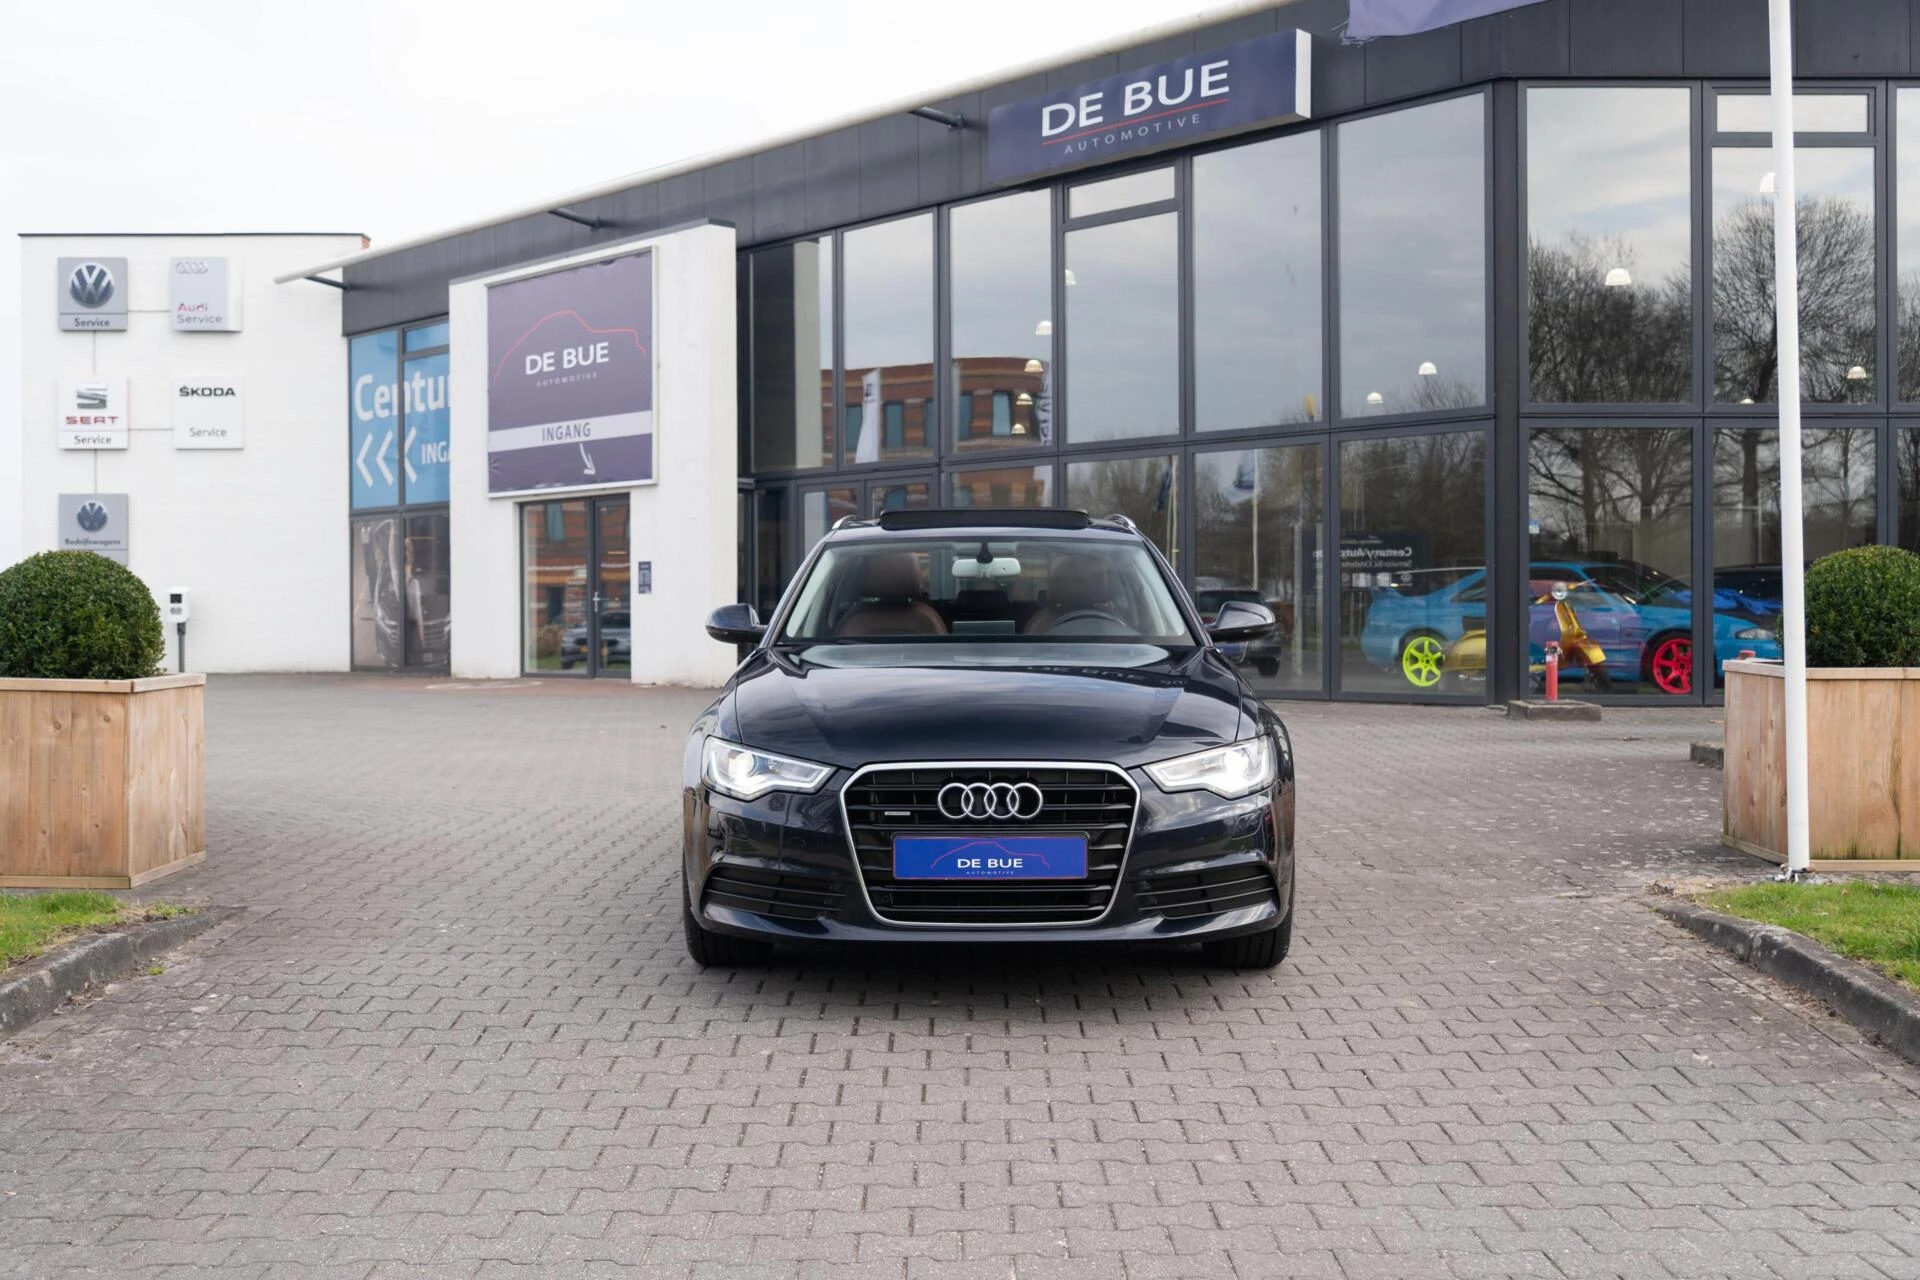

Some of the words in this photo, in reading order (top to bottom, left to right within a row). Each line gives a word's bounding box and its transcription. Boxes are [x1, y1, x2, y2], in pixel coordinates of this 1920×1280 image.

[1041, 91, 1104, 137] DE
[1123, 59, 1230, 117] BUE
[1063, 113, 1201, 155] AUTOMOTIVE
[177, 303, 209, 313] Audi
[74, 317, 111, 328] Service
[177, 314, 223, 324] Service
[525, 351, 556, 375] DE
[562, 341, 610, 369] BUE
[536, 371, 598, 387] AUTOMOTIVE
[355, 370, 450, 421] Centu
[65, 416, 119, 425] SEAT
[189, 427, 228, 438] Service
[541, 422, 592, 442] INGANG
[74, 435, 112, 445] Service
[421, 441, 450, 464] ING
[957, 858, 982, 869] DE
[987, 858, 1024, 869] BUE
